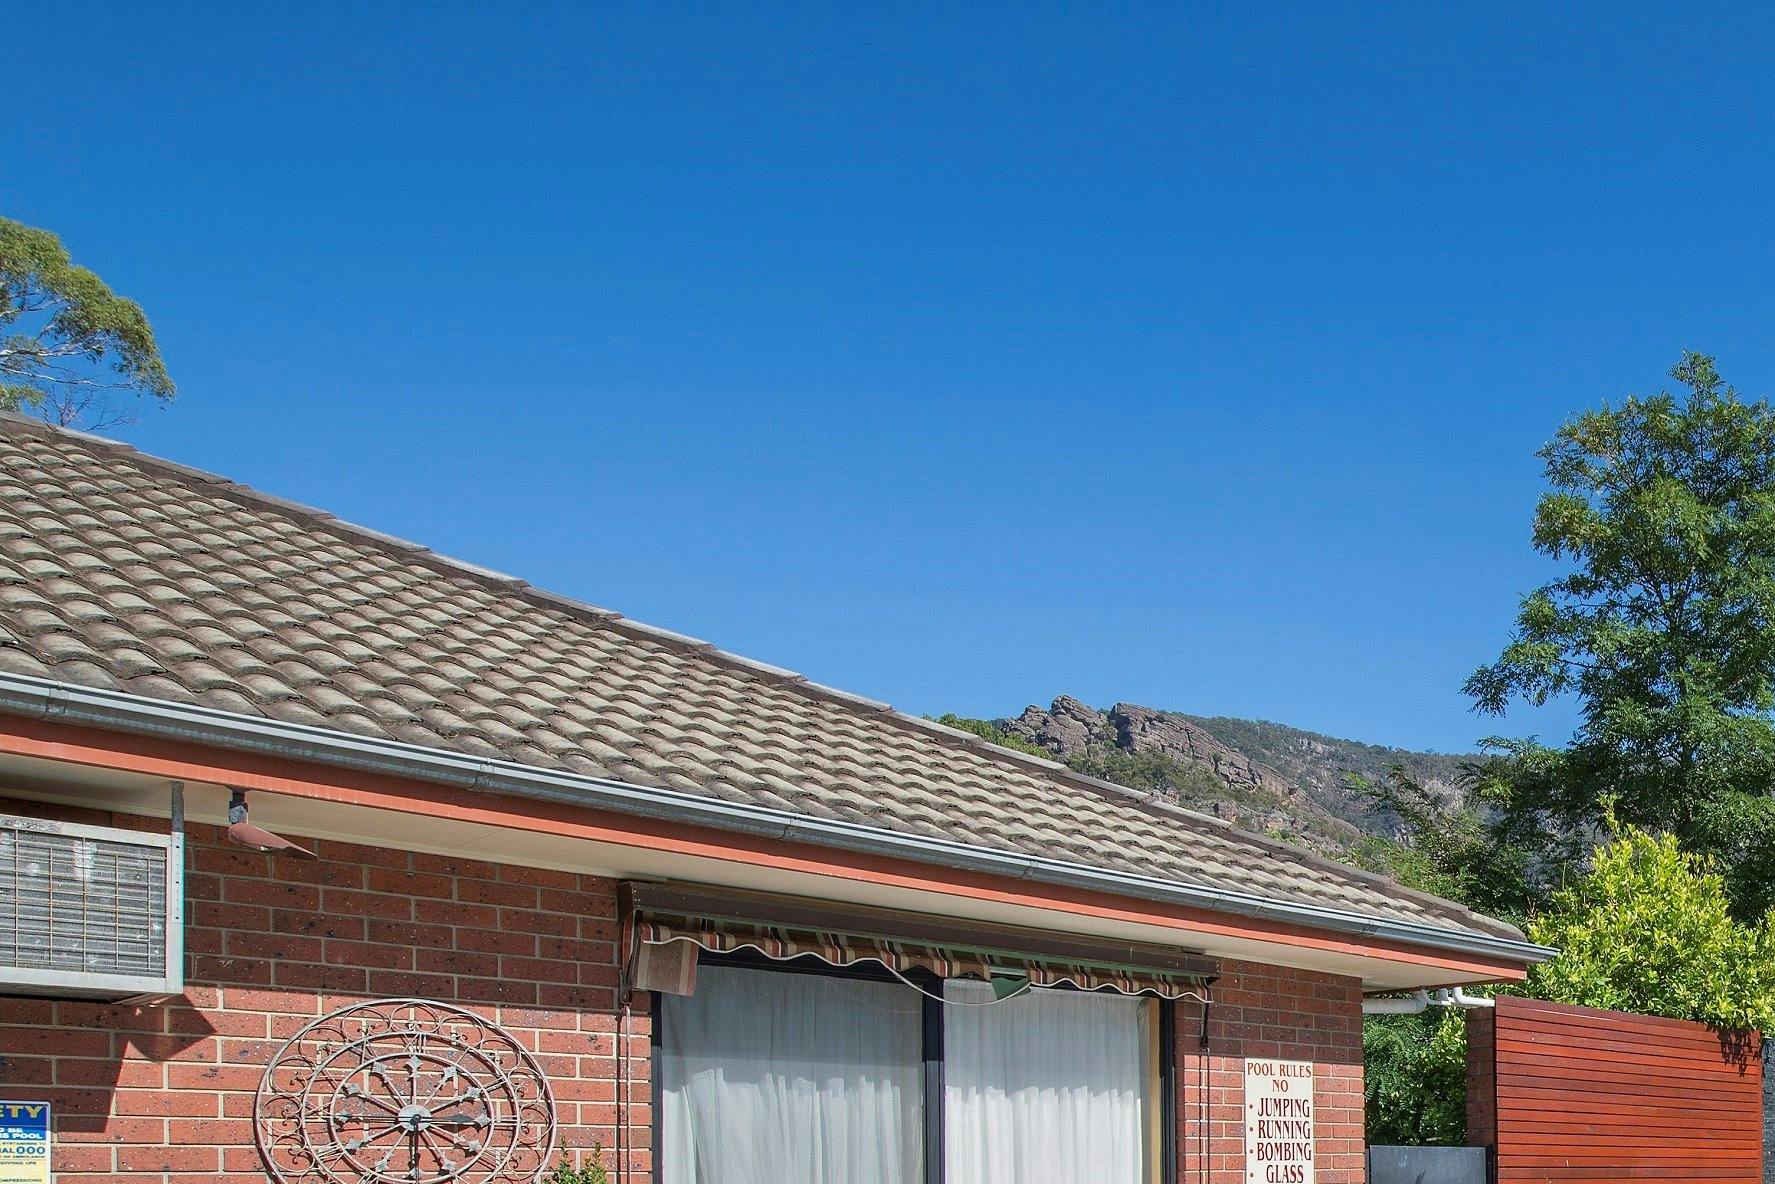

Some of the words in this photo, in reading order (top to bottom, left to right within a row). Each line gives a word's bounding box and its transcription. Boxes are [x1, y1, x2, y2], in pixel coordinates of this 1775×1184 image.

[1247, 1062, 1276, 1076] POOL
[1279, 1064, 1312, 1078] RULES
[1272, 1079, 1289, 1092] NO
[0, 1105, 43, 1118] TY
[1257, 1098, 1310, 1118] JUMPING
[1258, 1120, 1311, 1140] RUNNING
[1256, 1142, 1312, 1161] BOMBING
[1266, 1164, 1304, 1184] GLASS
